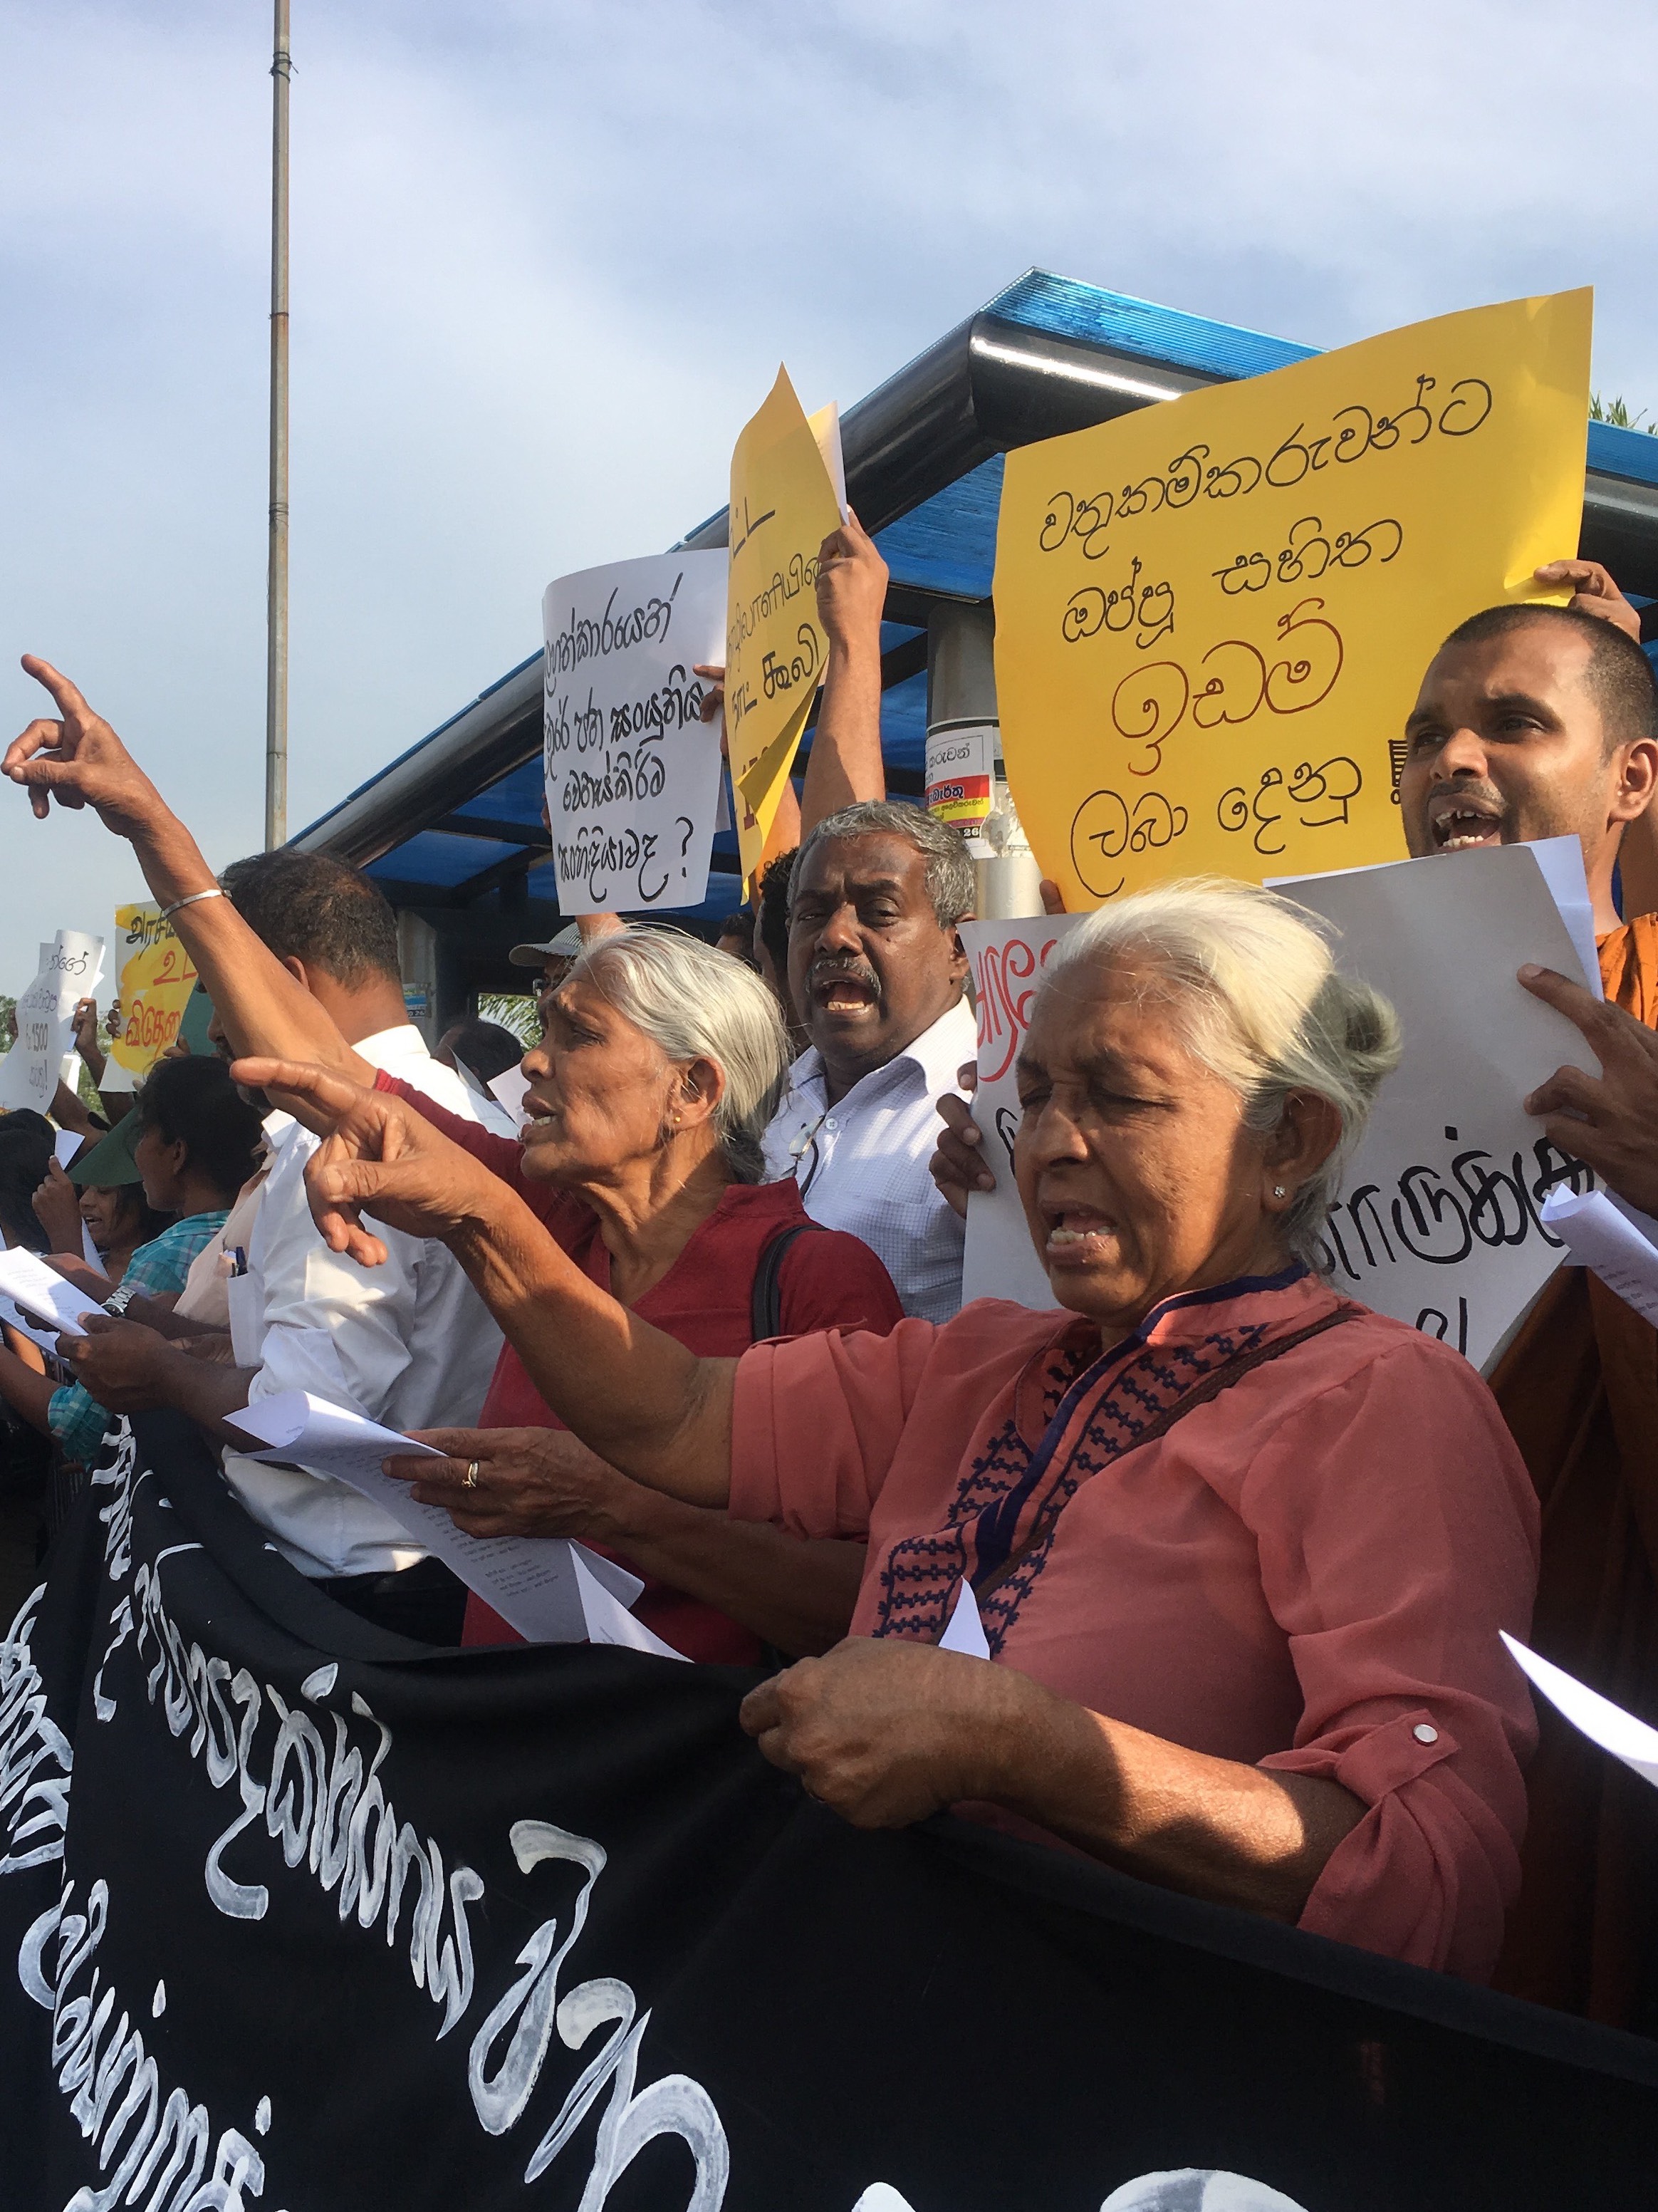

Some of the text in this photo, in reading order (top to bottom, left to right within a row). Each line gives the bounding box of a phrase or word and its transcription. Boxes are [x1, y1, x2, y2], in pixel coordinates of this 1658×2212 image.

[1211, 516, 1403, 596] සහිත
[1111, 597, 1344, 777] ඉඩම්
[1070, 790, 1189, 898] ලබා
[1217, 757, 1362, 855] දෙනු
